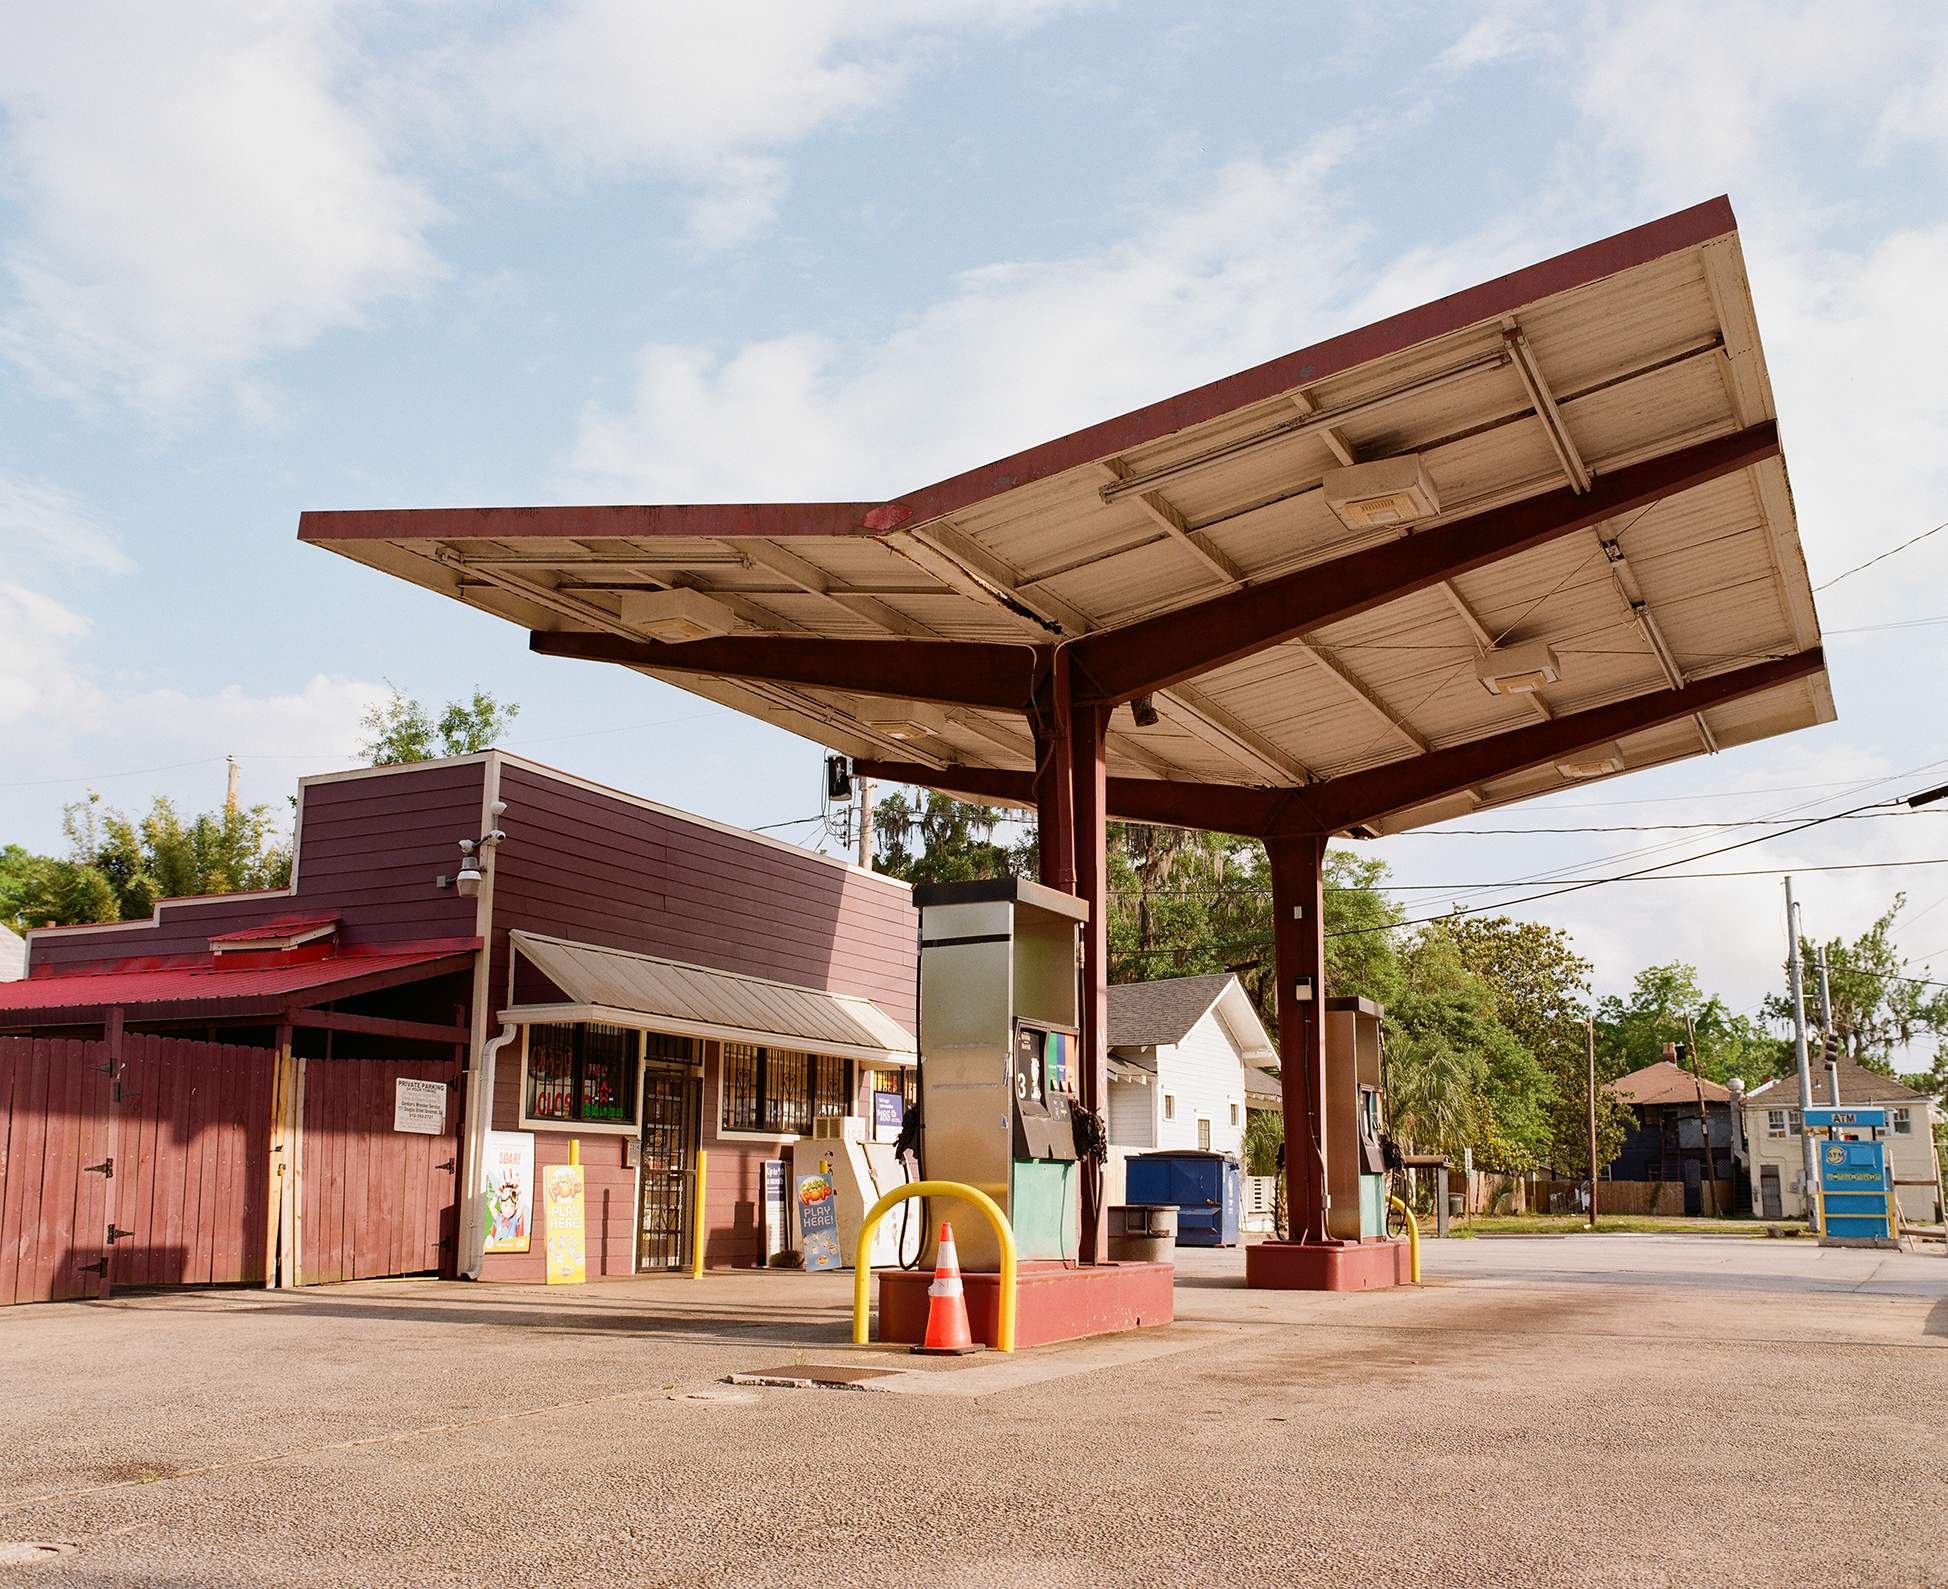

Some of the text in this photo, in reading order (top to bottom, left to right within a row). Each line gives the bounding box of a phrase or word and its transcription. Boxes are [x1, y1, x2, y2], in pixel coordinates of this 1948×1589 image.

[398, 1080, 444, 1091] PRIVATE PARKING
[1018, 1073, 1026, 1099] 3
[1833, 1114, 1855, 1123] ATM
[499, 1152, 521, 1165] SOAR!
[549, 1181, 582, 1203] POP
[800, 1186, 831, 1206] POP
[552, 1206, 580, 1217] PLAY
[804, 1206, 830, 1217] PLAY
[550, 1217, 582, 1229] HERE!
[803, 1215, 834, 1228] HERE!
